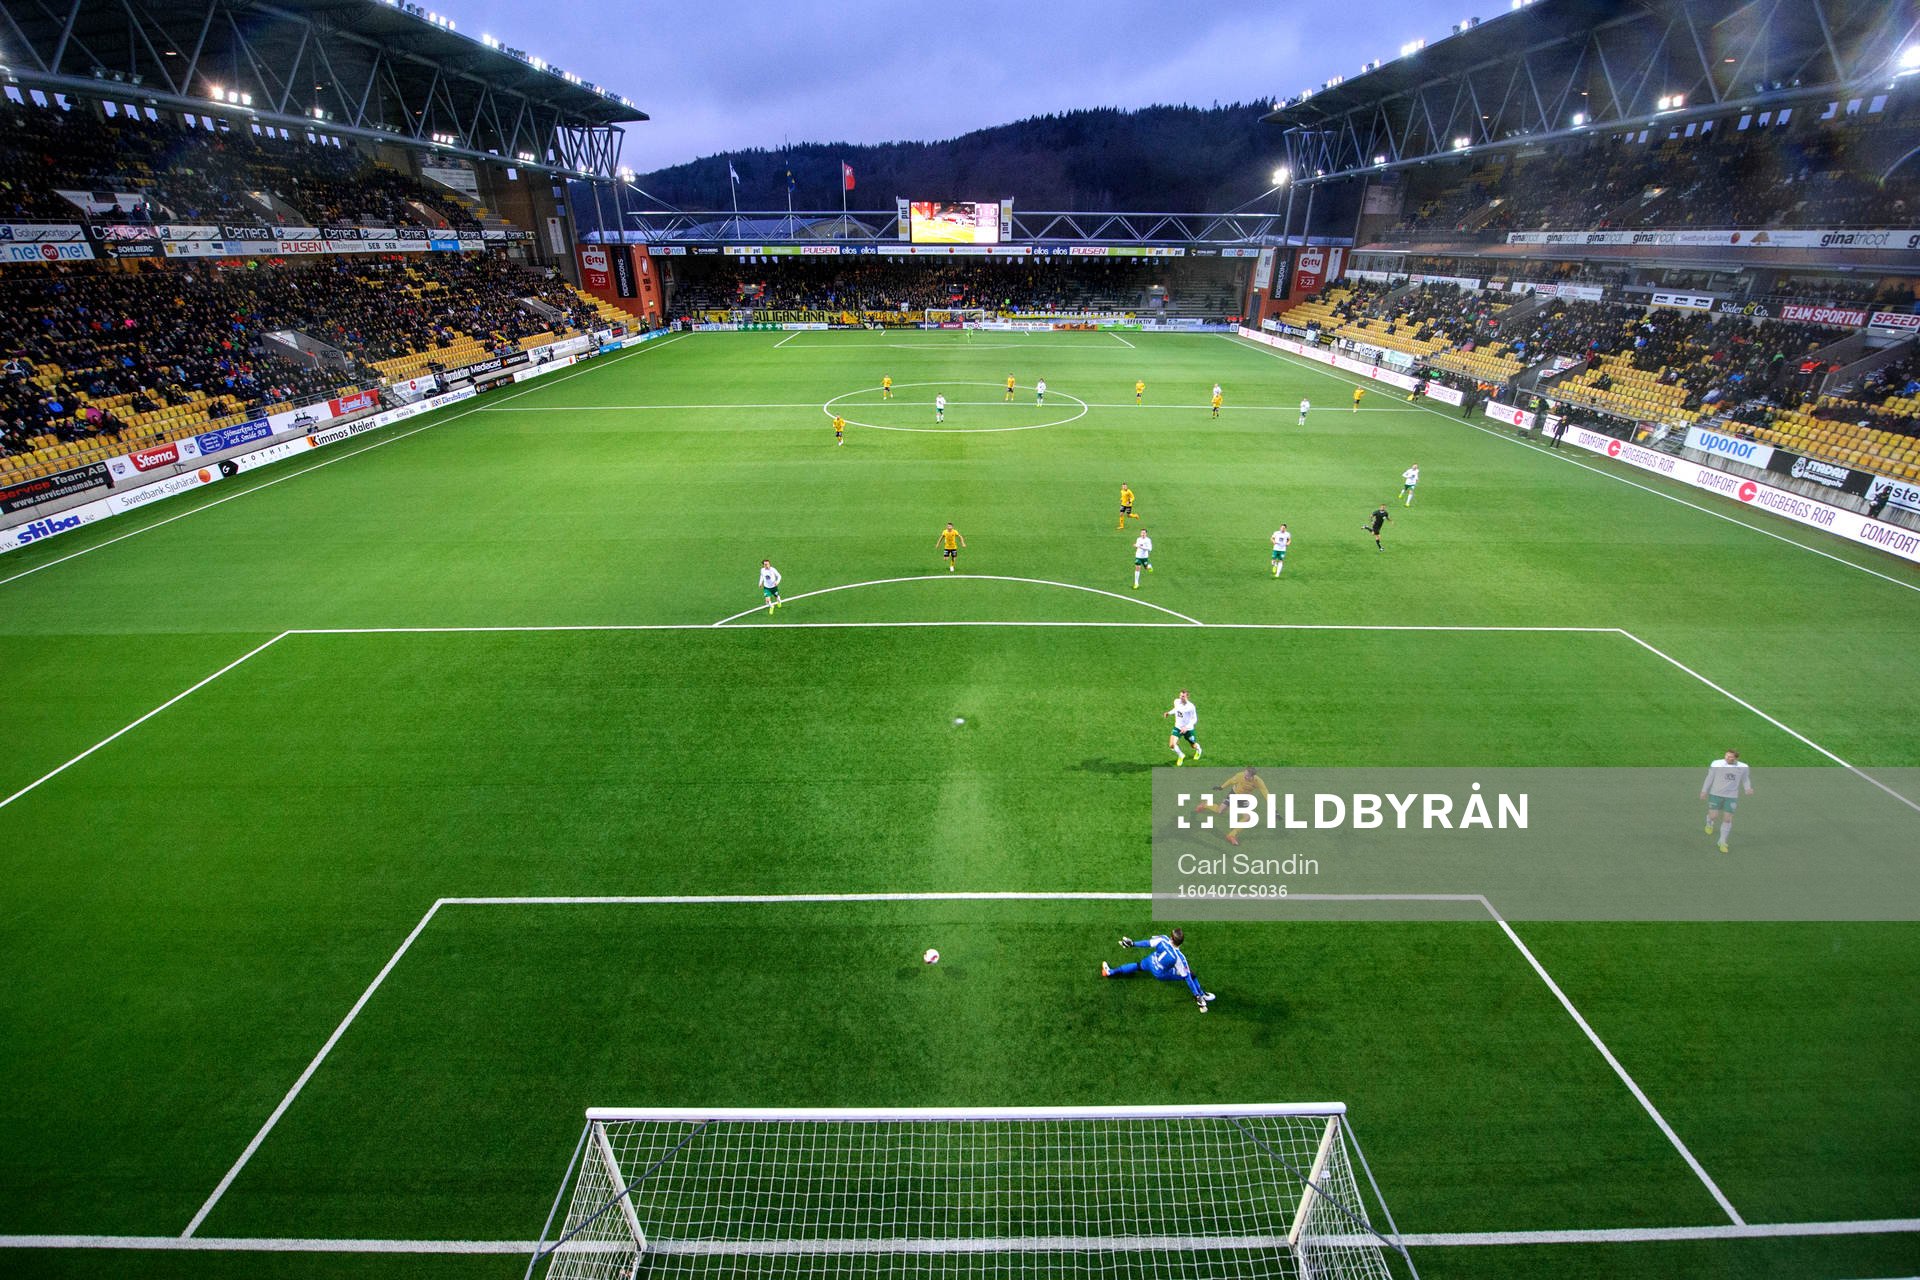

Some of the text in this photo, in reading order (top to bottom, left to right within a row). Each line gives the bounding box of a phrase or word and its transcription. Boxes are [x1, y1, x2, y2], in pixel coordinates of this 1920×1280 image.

[281, 241, 322, 253] PULSEN
[1782, 306, 1865, 326] TEAM SPORTIA
[1873, 313, 1920, 327] SPEED
[311, 429, 349, 446] Kimmos
[1578, 432, 1608, 451] COMFORT
[1699, 432, 1757, 459] uponor
[51, 471, 87, 486] Team
[88, 464, 107, 476] AB
[121, 484, 166, 507] Swedbank
[1697, 470, 1738, 493] COMFORT
[1758, 488, 1811, 518] HÖGBERGS
[1810, 506, 1836, 527] RÖR
